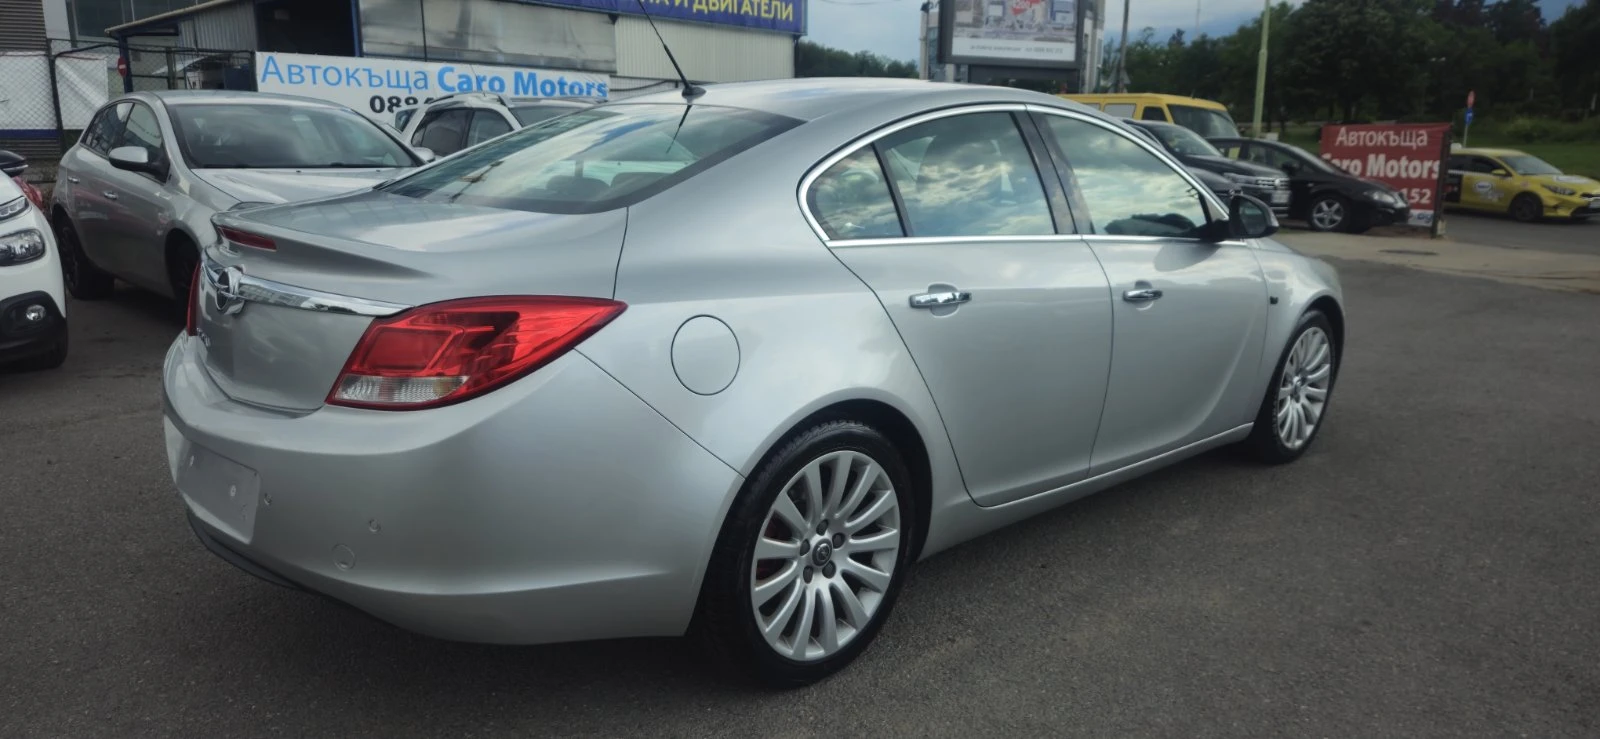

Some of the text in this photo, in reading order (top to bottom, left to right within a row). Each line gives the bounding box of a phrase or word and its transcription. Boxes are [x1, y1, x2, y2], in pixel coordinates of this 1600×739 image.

[693, 0, 793, 22] ДВИГАТЕЛИ
[260, 54, 609, 98] Автокъща Caro Motors
[1334, 126, 1428, 150] Автокъща
